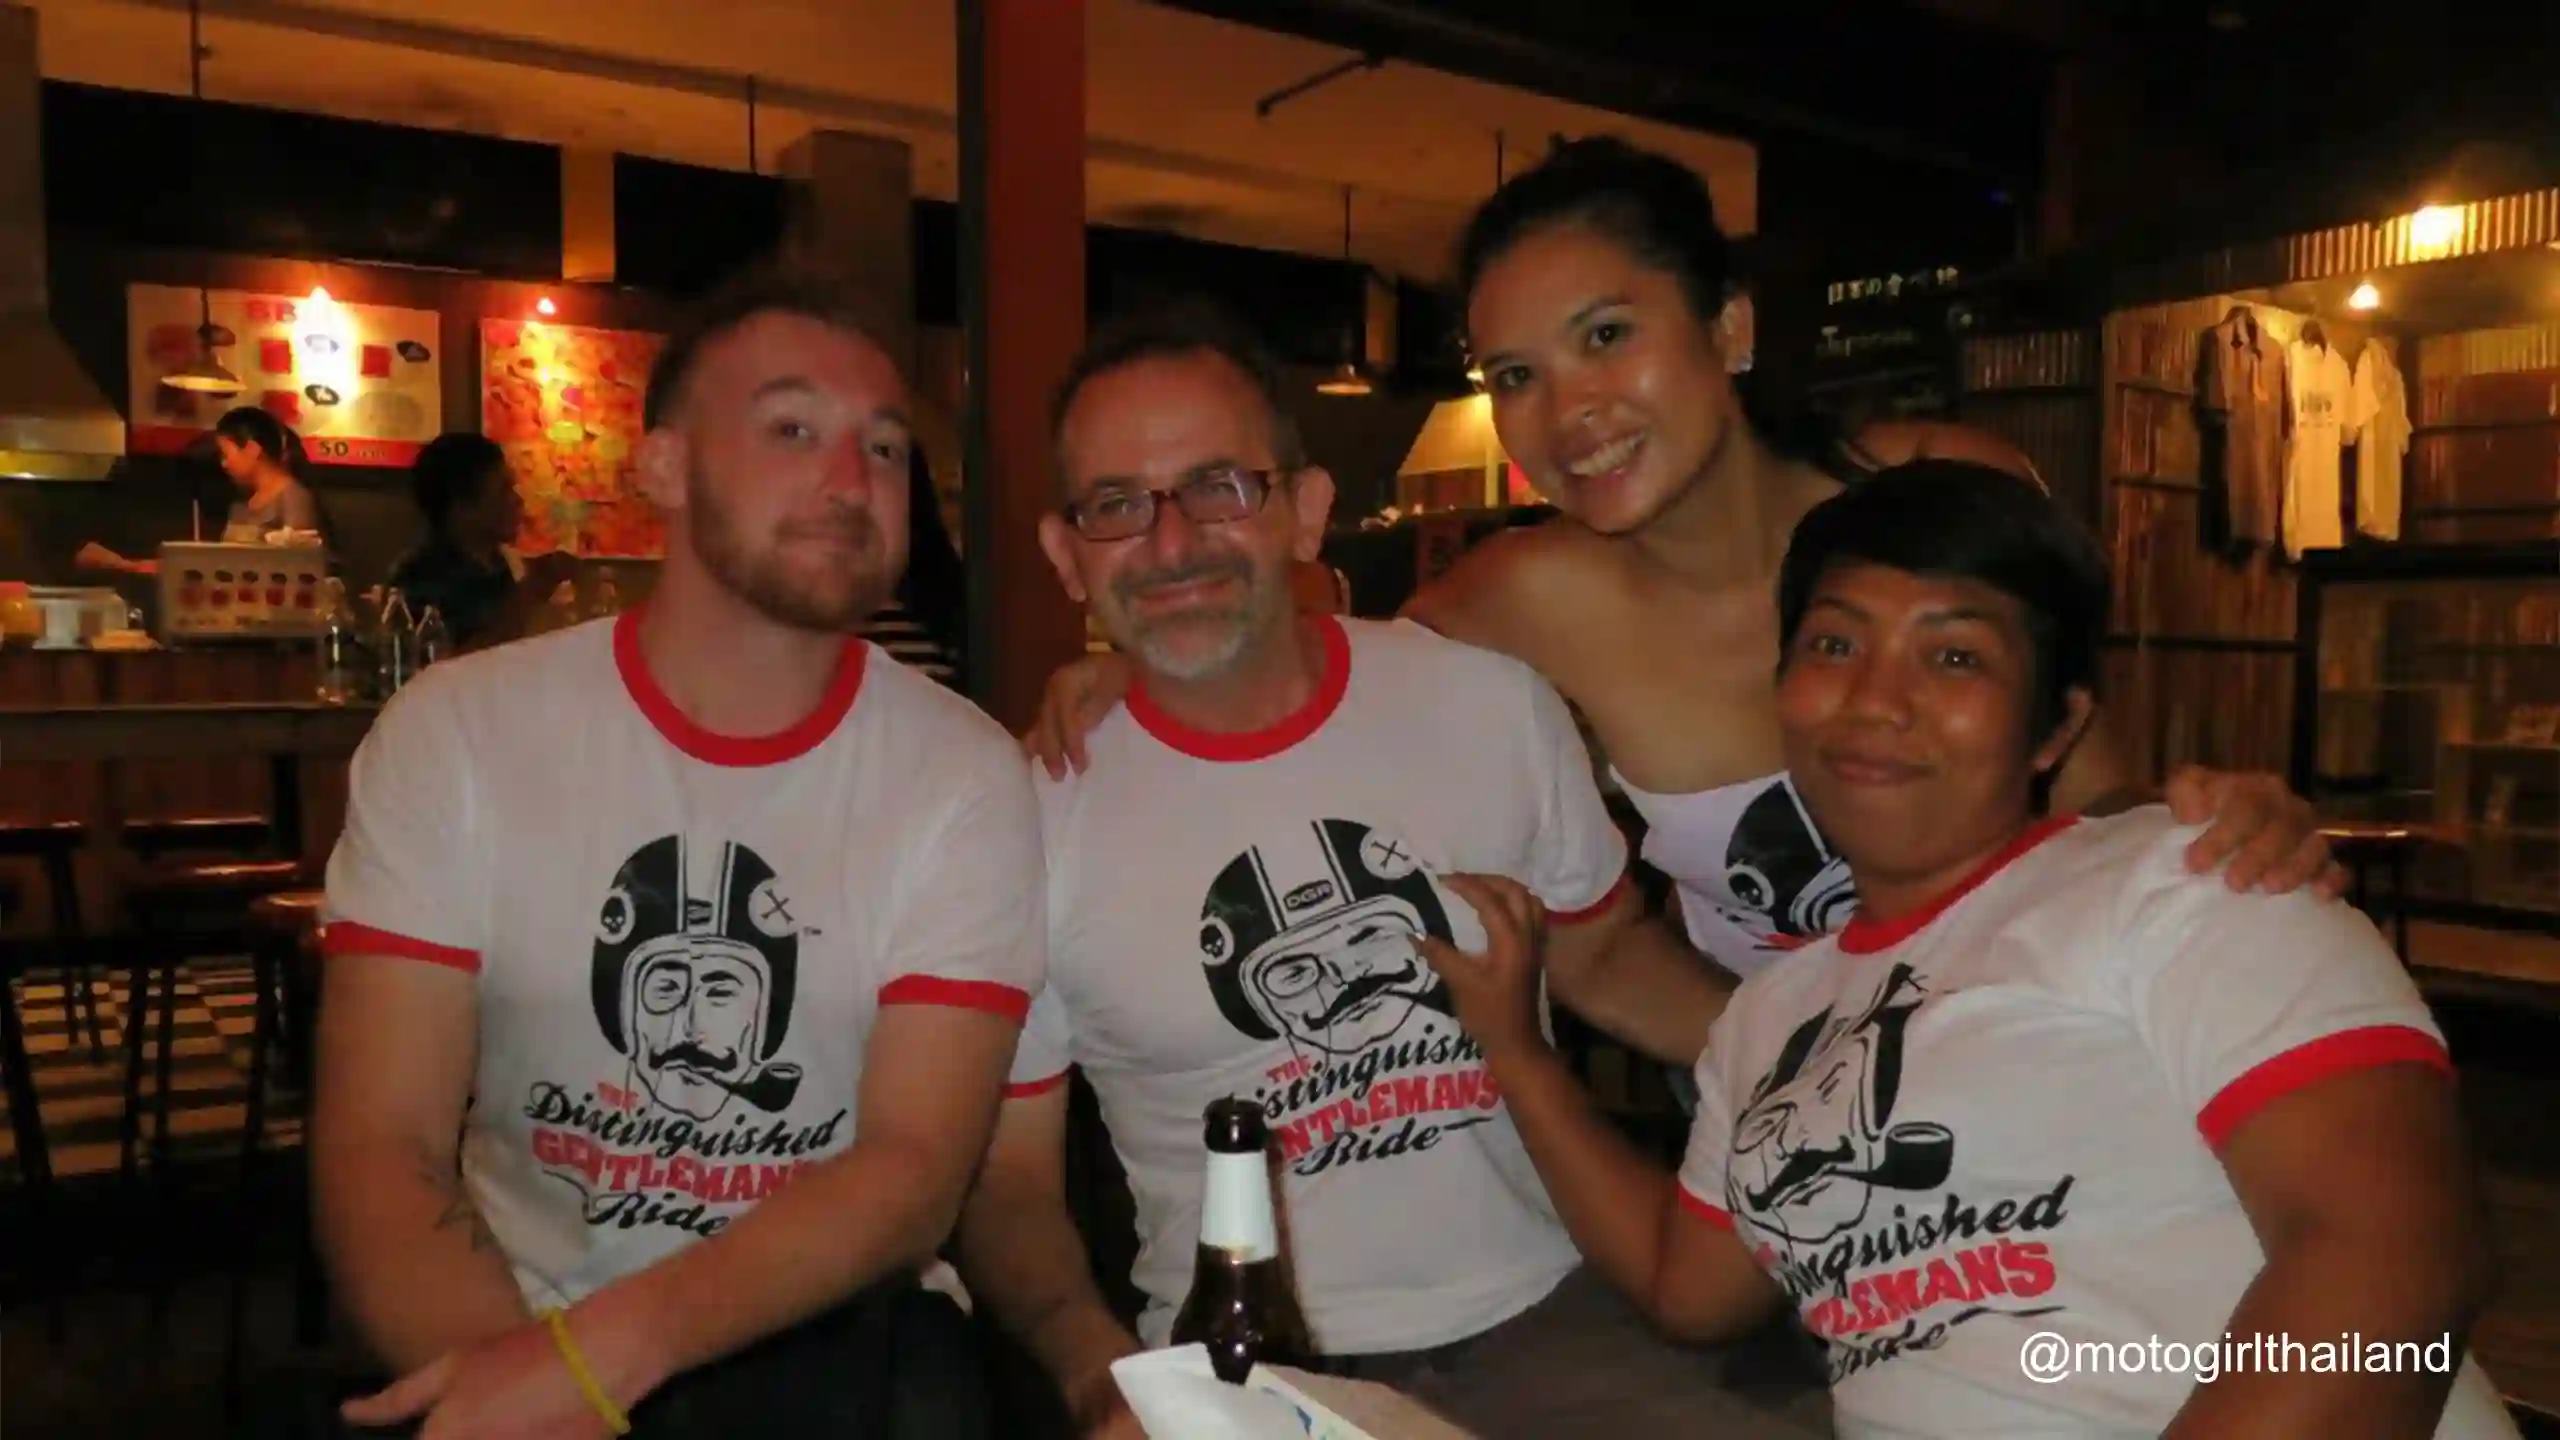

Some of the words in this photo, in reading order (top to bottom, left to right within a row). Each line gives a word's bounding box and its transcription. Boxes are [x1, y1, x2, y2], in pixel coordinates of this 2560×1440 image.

[523, 1081, 847, 1159] Distinguished
[1294, 1117, 1442, 1177] Ride
[582, 1189, 732, 1237] Ride
